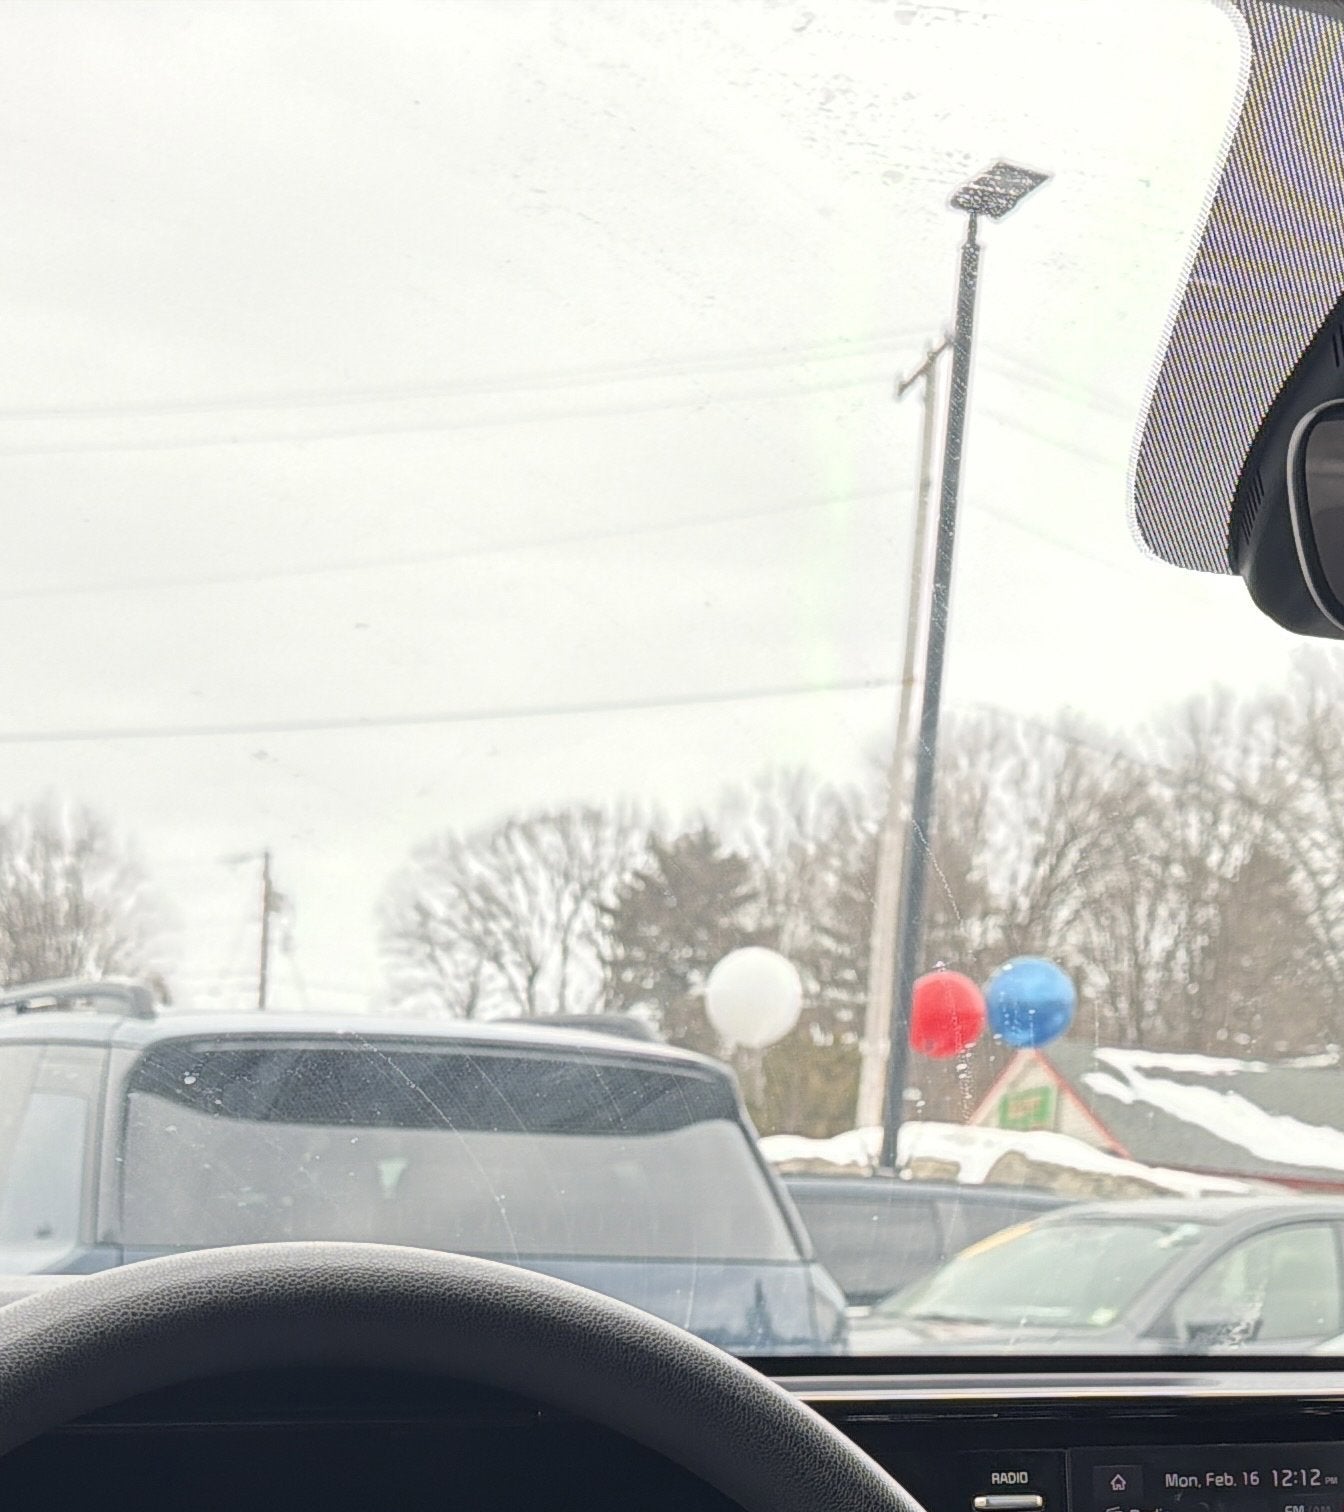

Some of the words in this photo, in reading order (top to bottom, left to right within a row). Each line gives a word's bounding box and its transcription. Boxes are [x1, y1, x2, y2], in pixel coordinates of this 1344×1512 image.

[991, 1471, 1029, 1485] RADIO
[1206, 1472, 1237, 1487] Feb.
[1242, 1471, 1260, 1486] 16
[1272, 1468, 1321, 1487] 12:12
[1324, 1476, 1338, 1485] PM
